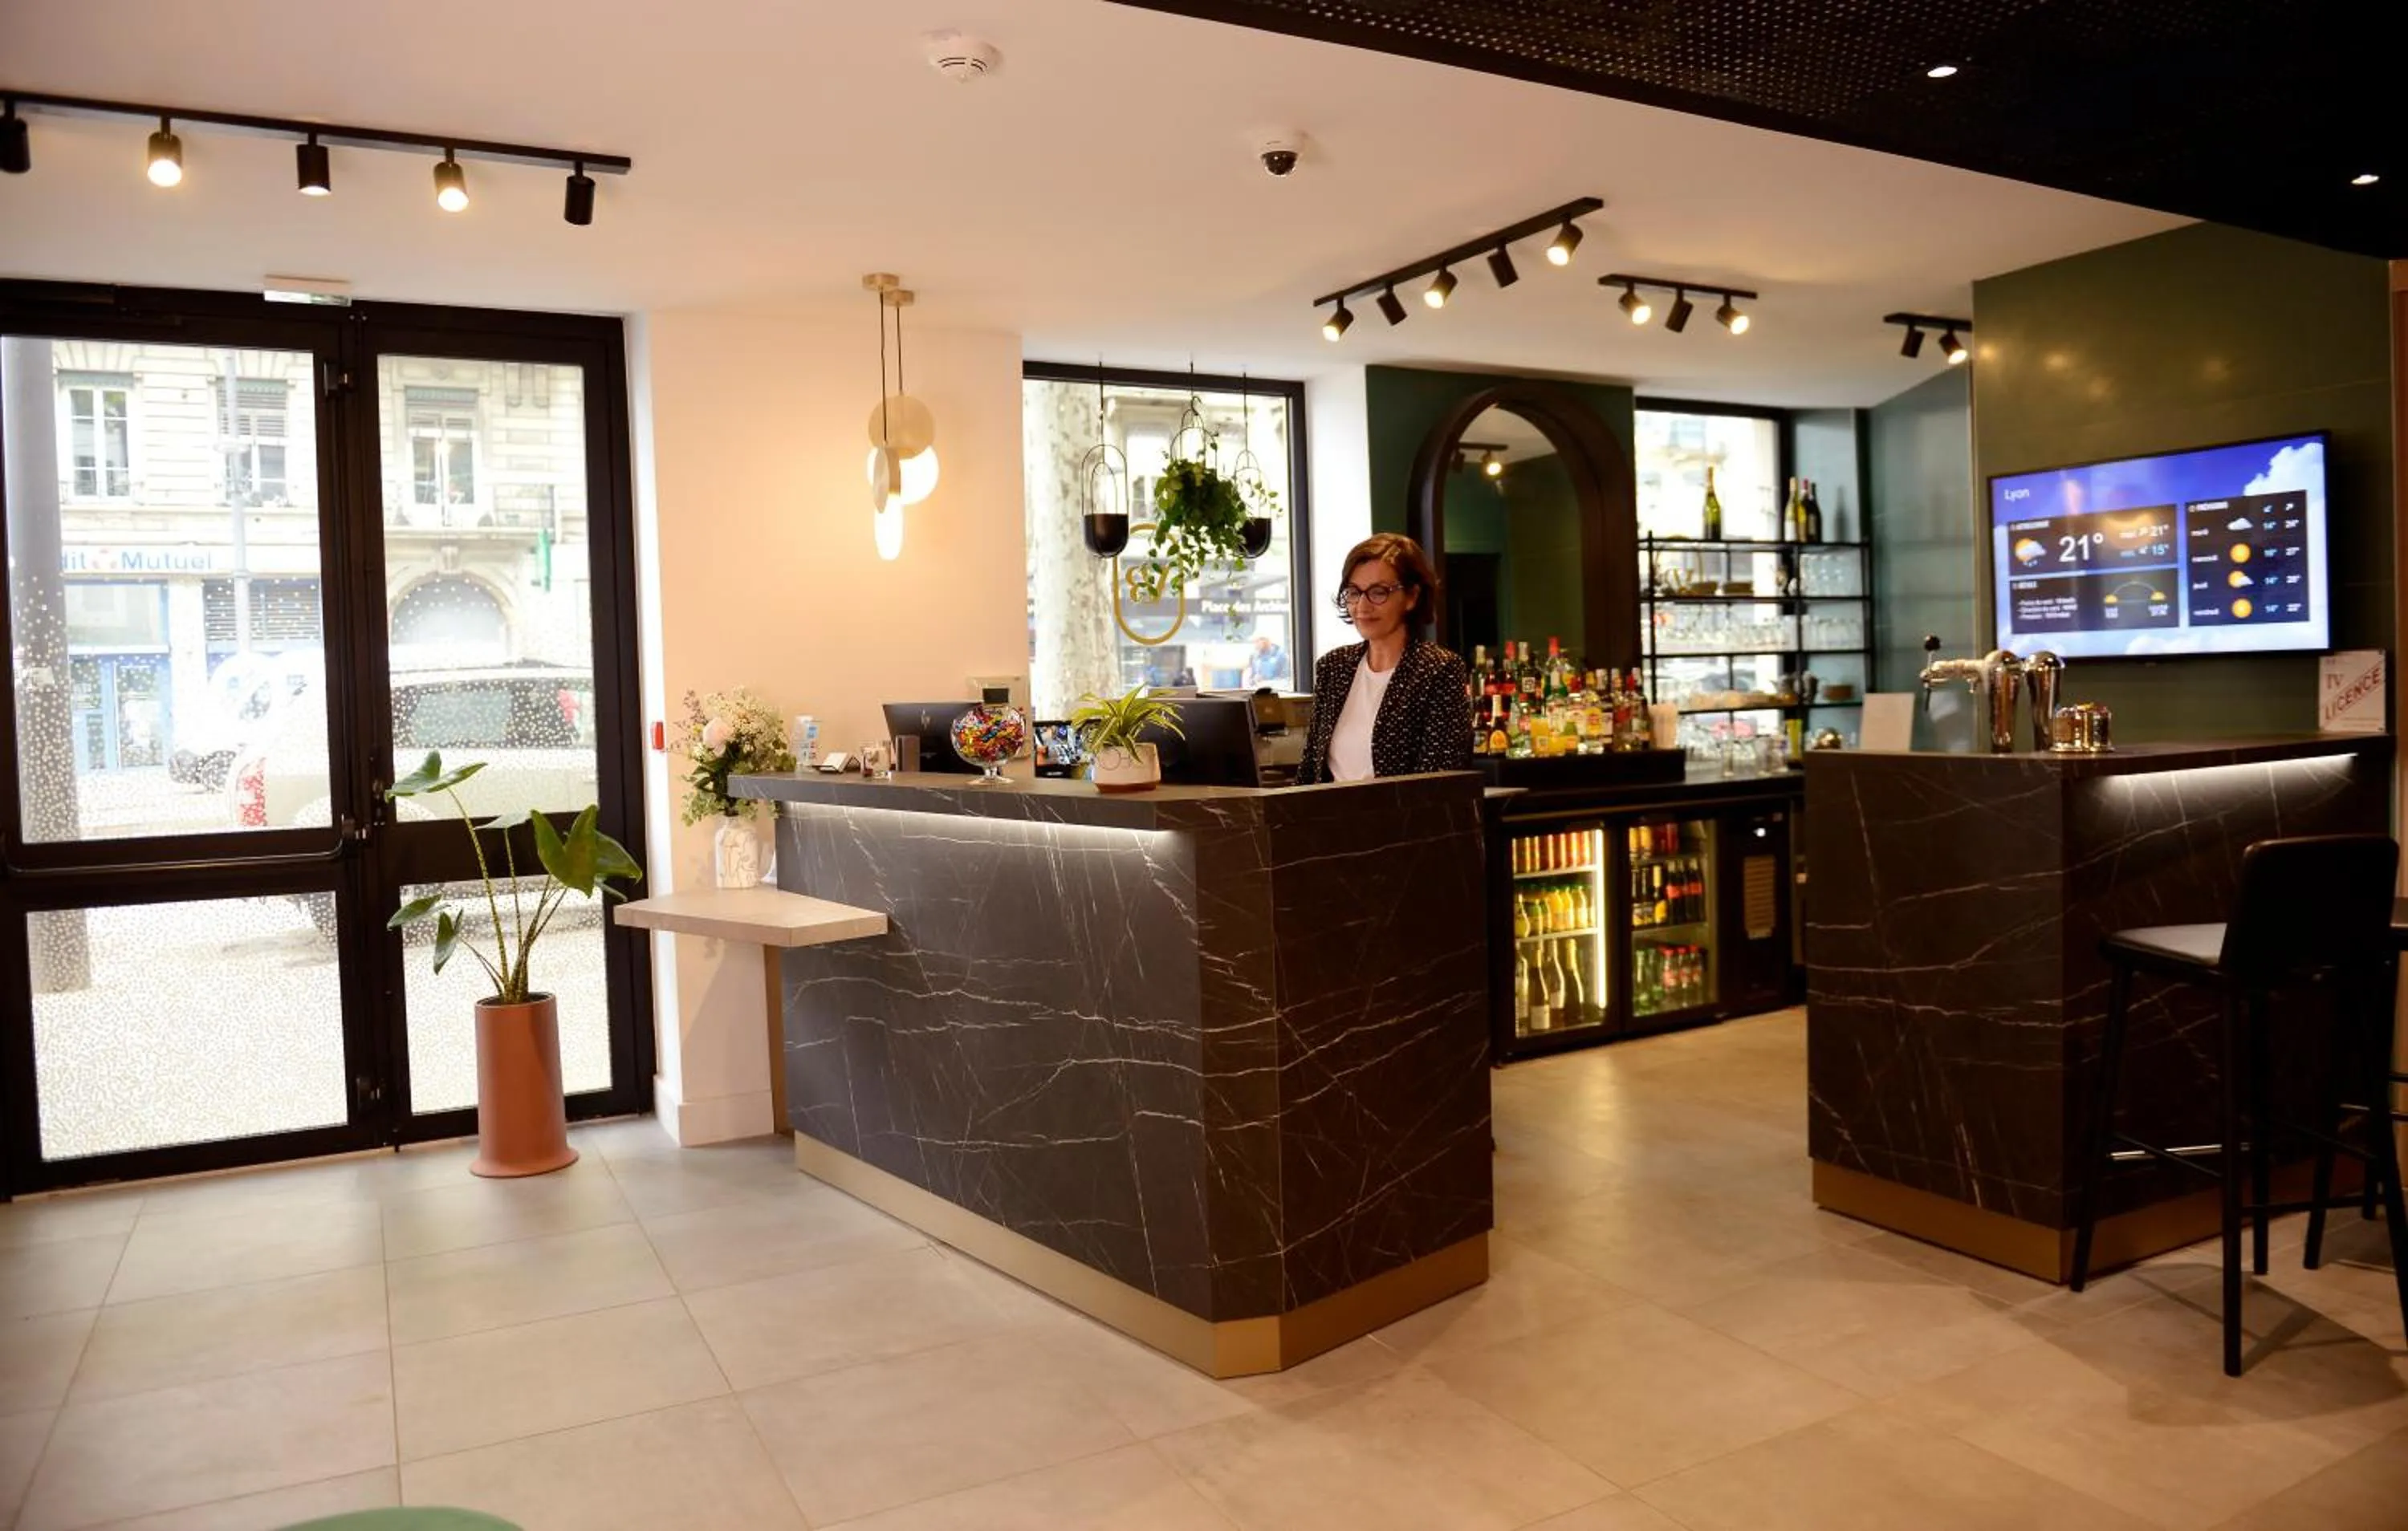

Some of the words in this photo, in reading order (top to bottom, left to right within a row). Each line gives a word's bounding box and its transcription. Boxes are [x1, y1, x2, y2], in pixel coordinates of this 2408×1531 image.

[2004, 489, 2030, 502] Lyon
[2059, 532, 2104, 562] 21°
[61, 551, 86, 571] dit
[122, 551, 211, 570] Mutuel
